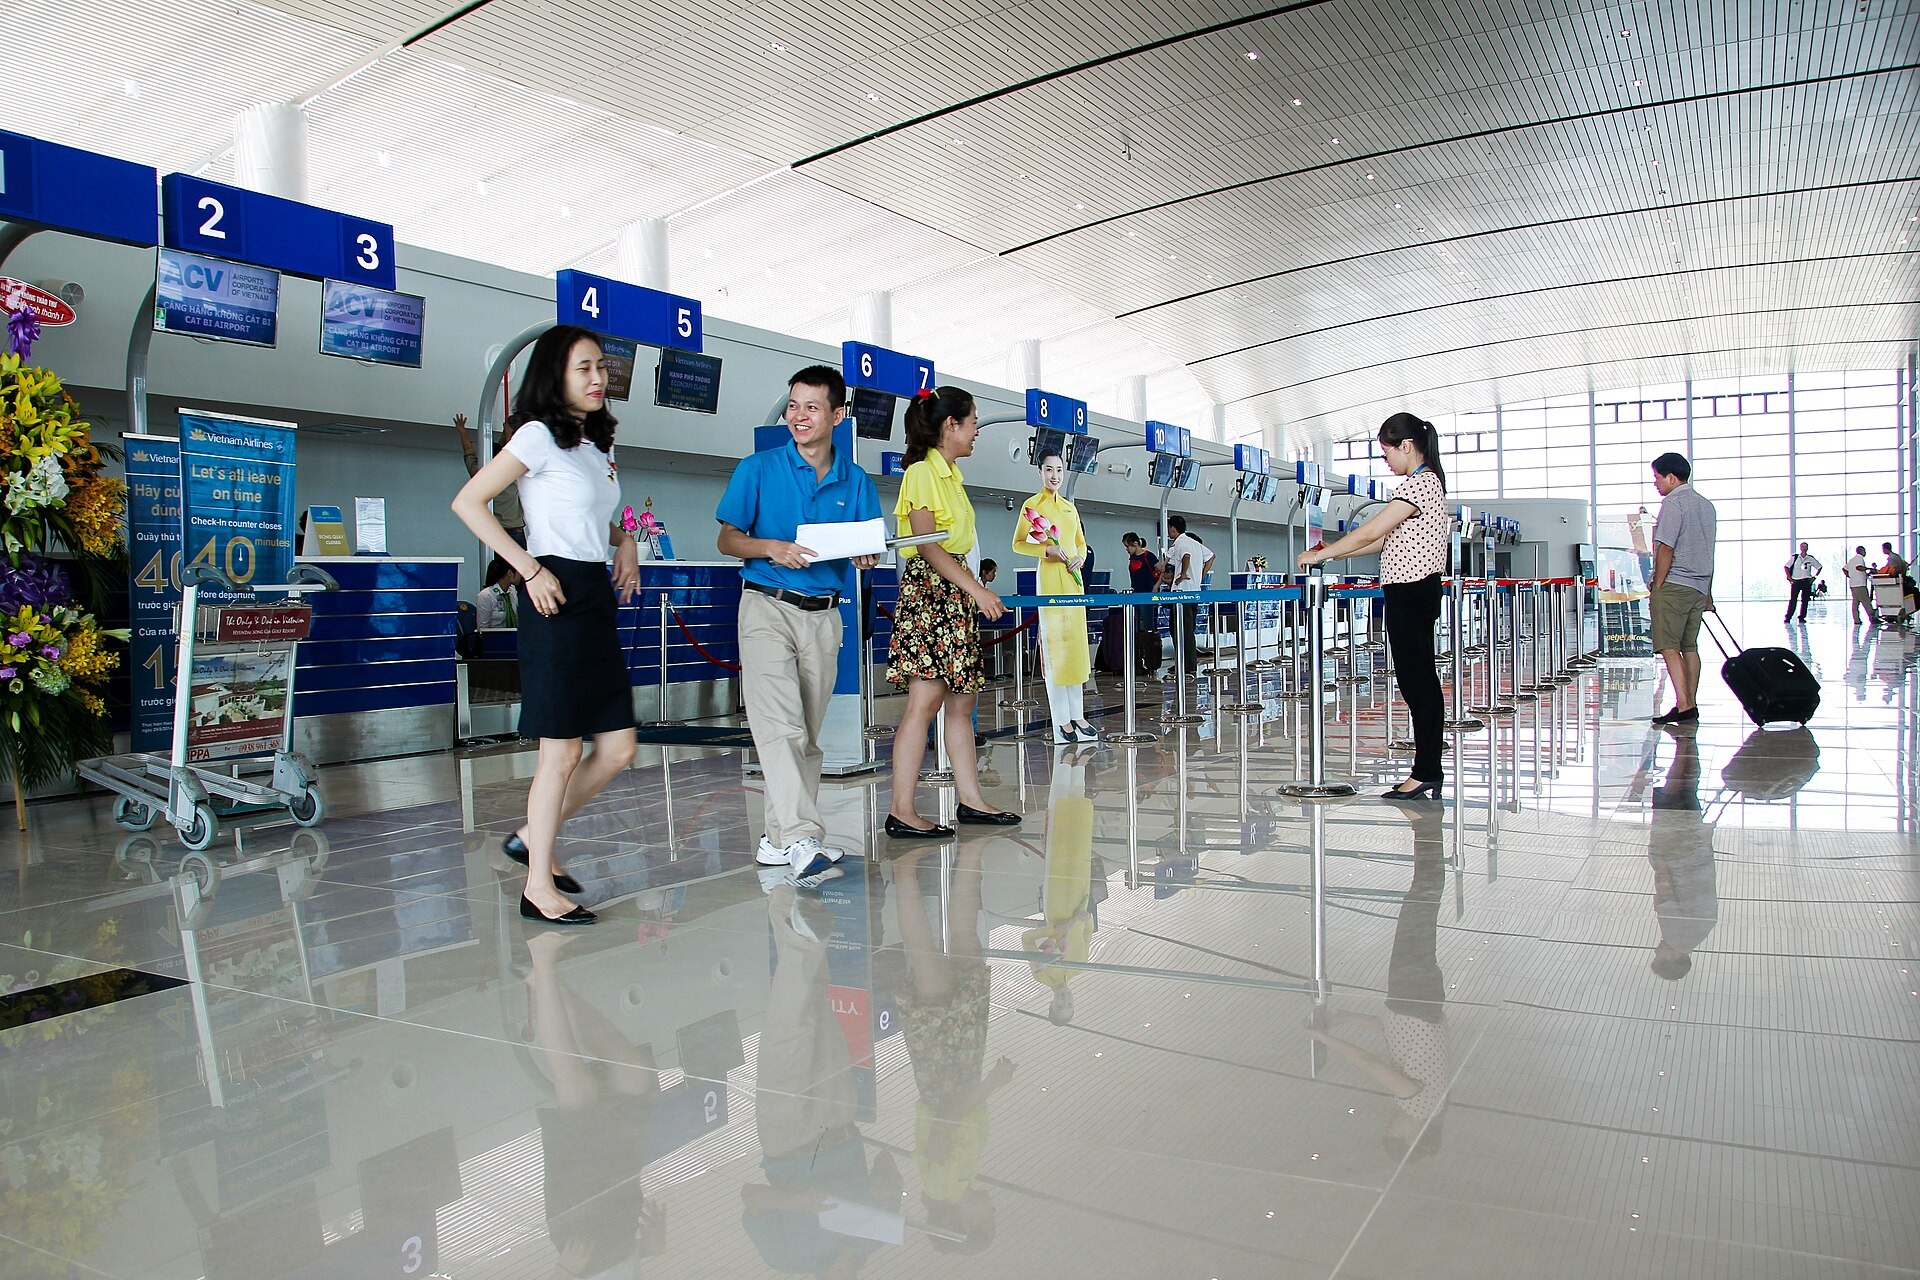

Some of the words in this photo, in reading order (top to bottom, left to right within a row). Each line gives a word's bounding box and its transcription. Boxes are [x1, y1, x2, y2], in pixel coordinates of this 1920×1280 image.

[197, 196, 226, 239] 2
[356, 233, 380, 271] 3
[163, 260, 224, 292] ACV
[232, 273, 264, 285] AIRPORTS
[231, 281, 278, 295] CORPORATION
[231, 289, 241, 297] OF
[241, 291, 269, 301] VIETNAM
[581, 286, 600, 319] 4
[384, 307, 422, 319] CORPORATION
[393, 316, 416, 326] VIETNAM
[185, 315, 202, 325] CAT
[203, 318, 212, 327] BI
[214, 320, 251, 333] AIRPORT
[677, 307, 693, 338] 5
[346, 339, 360, 348] CAT
[361, 342, 369, 350] BI
[370, 343, 401, 354] AIRPORT
[861, 352, 873, 378] 6
[919, 366, 929, 389] 7
[1040, 398, 1048, 418] 8
[1076, 407, 1084, 427] 9
[206, 432, 243, 446] Vietnam
[242, 437, 274, 450] Airlines
[1155, 428, 1165, 446] 10
[1182, 433, 1190, 451] 11
[192, 463, 226, 480] Let's
[229, 468, 245, 482] all
[248, 470, 282, 486] leave
[134, 483, 161, 500] Hãy
[212, 489, 230, 500] on
[233, 488, 262, 503] time
[227, 519, 257, 529] counter
[258, 521, 283, 531] closes
[254, 537, 291, 548] minutes
[218, 590, 256, 600] departure
[225, 615, 235, 626] The
[236, 616, 253, 628] Only
[261, 615, 273, 625] One
[273, 616, 281, 624] in
[282, 614, 305, 624] Vietnam
[158, 628, 167, 636] ra
